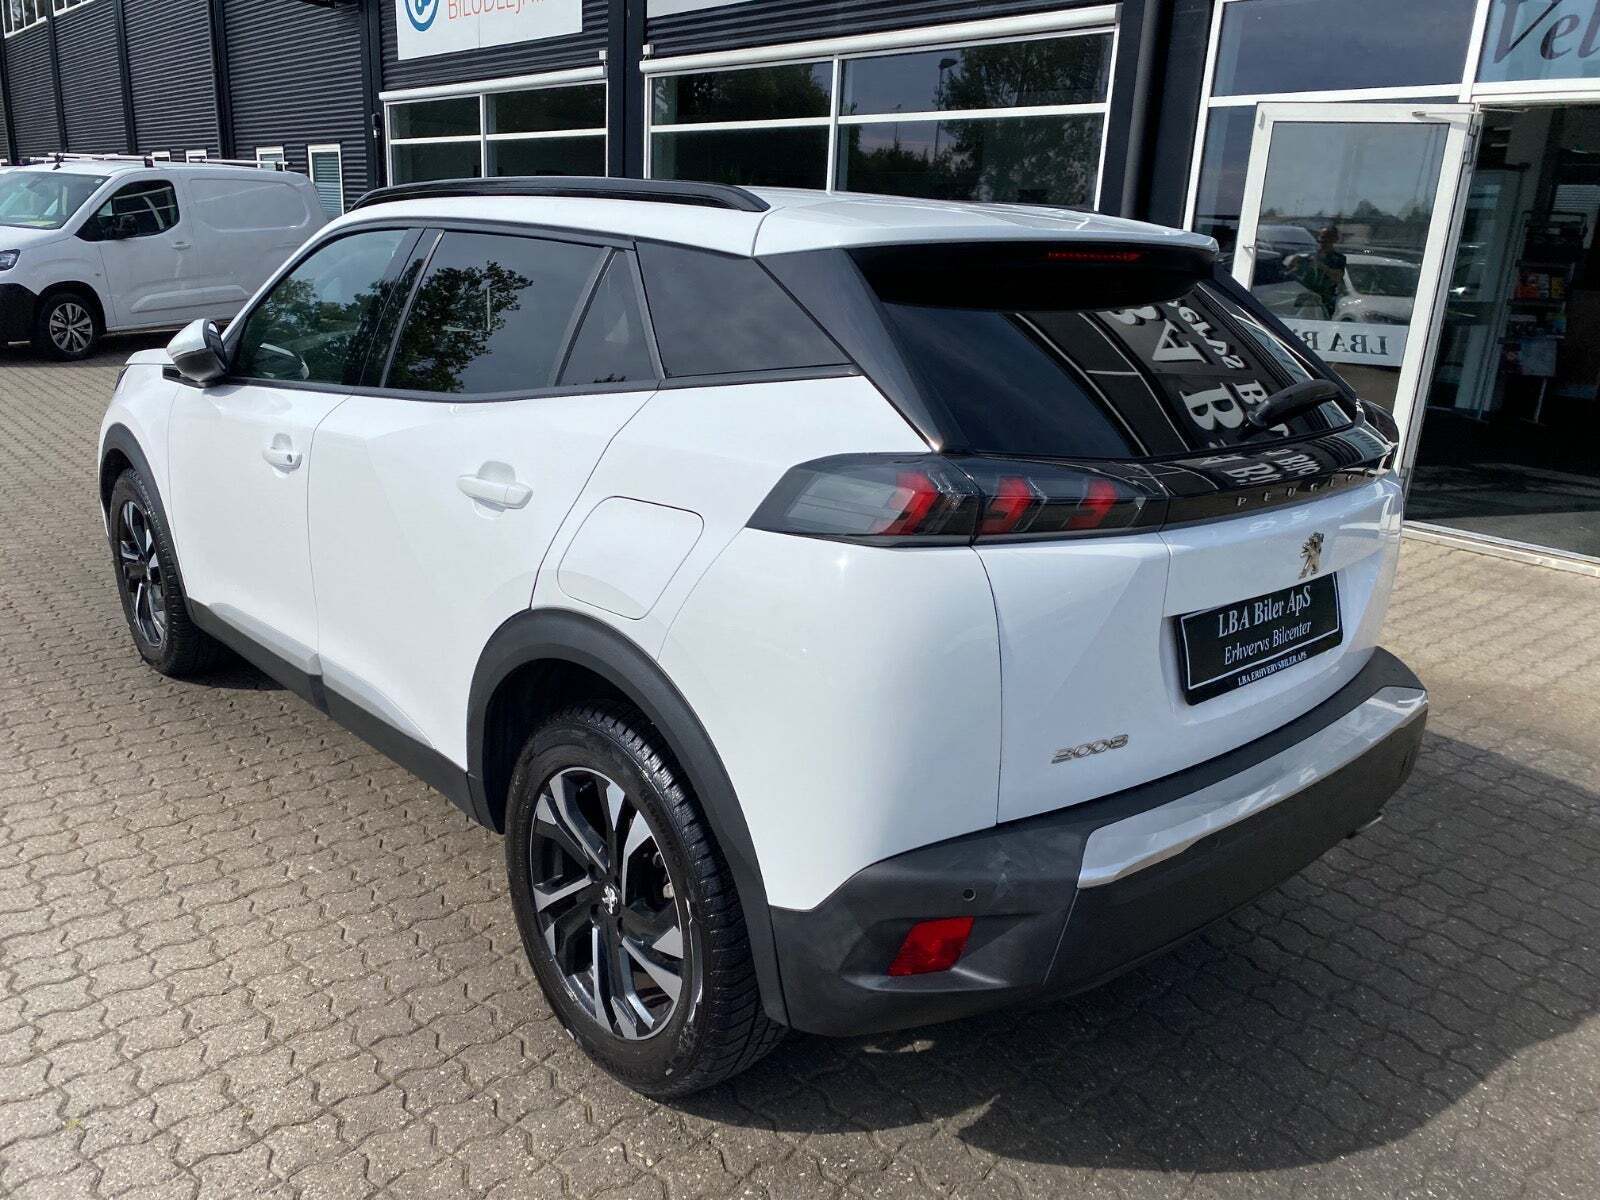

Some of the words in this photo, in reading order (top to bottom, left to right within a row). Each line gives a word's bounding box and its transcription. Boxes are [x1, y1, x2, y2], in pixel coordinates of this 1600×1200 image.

[1218, 605, 1251, 638] LBA
[1253, 598, 1285, 626] Biler
[1286, 585, 1311, 617] ApS
[1223, 637, 1270, 666] Erhvervs
[1272, 621, 1312, 648] Bilcenter
[1051, 734, 1129, 764] 2008
